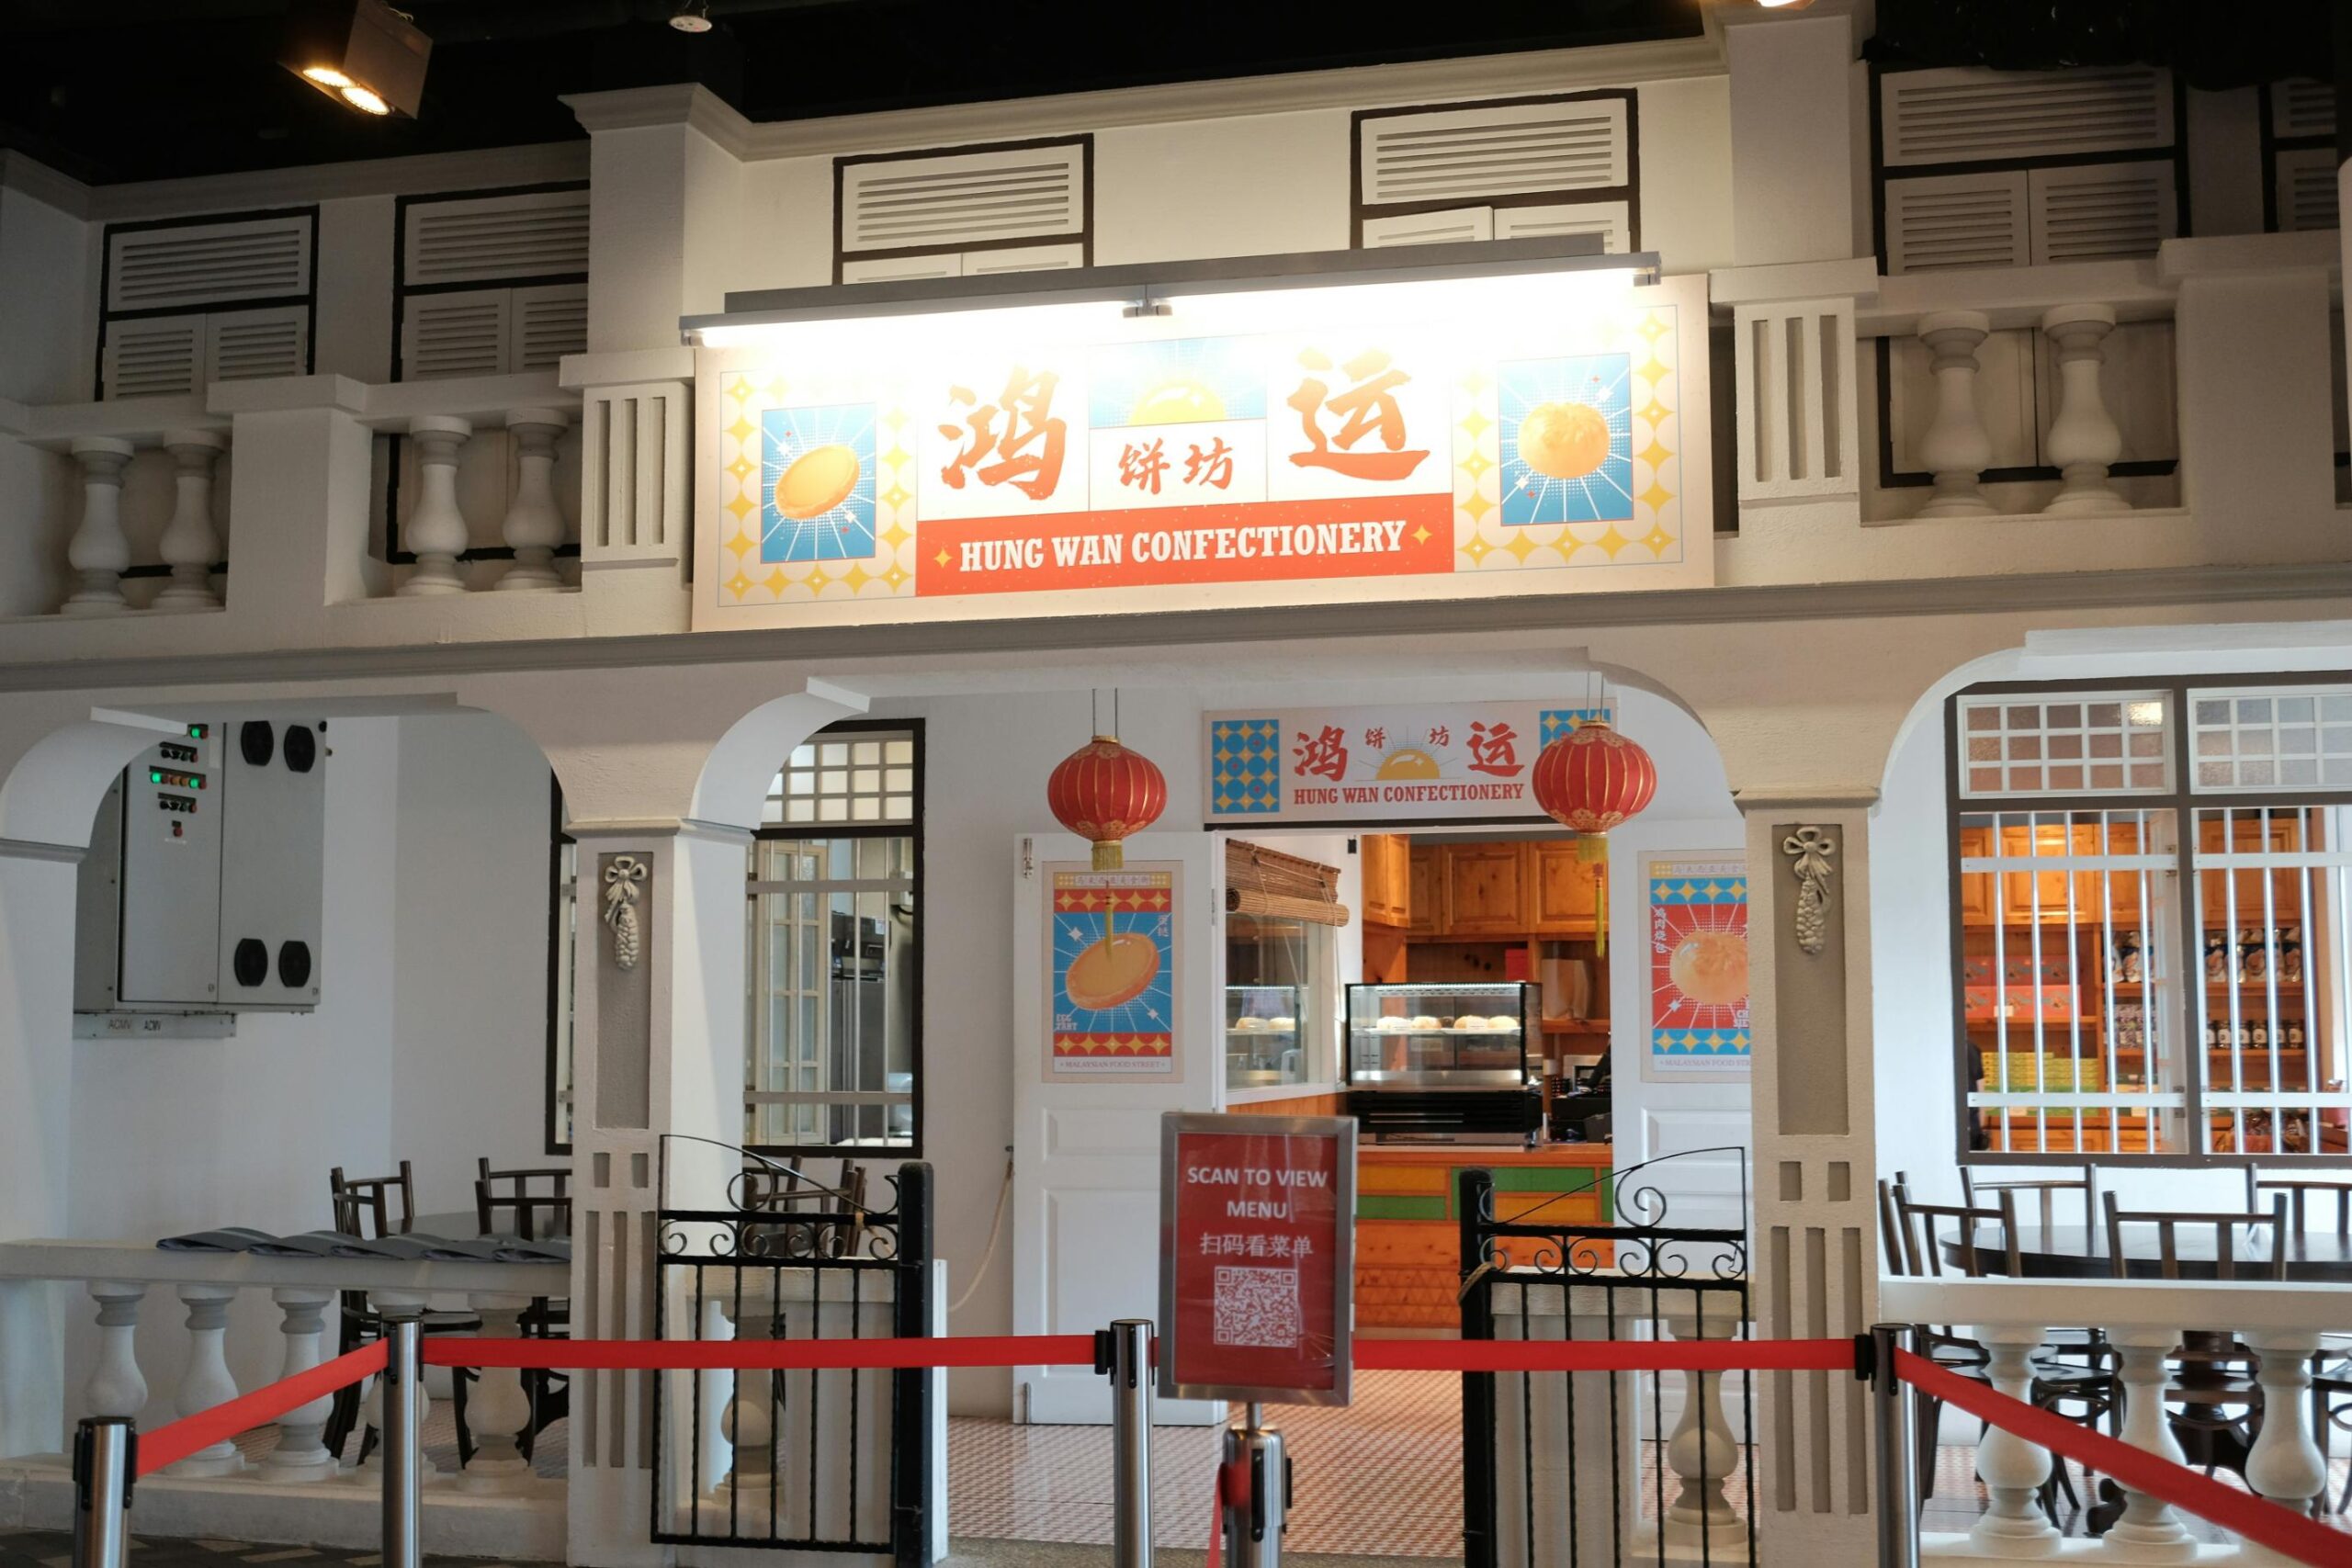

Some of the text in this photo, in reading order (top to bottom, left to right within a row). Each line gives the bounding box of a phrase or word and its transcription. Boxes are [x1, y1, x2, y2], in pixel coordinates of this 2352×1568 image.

[937, 346, 1430, 501] 鸿 运
[1118, 436, 1234, 495] 饼坊
[959, 520, 1407, 571] HUNG WAN CONFECTIONERY
[1293, 721, 1525, 782] 鸿 运
[1294, 783, 1525, 805] HUNG WAN CONFECTIONERY
[1187, 1167, 1329, 1188] SCAN TO VIEW
[1227, 1201, 1287, 1219] MENU
[1200, 1233, 1315, 1259] 扫码看菜单
